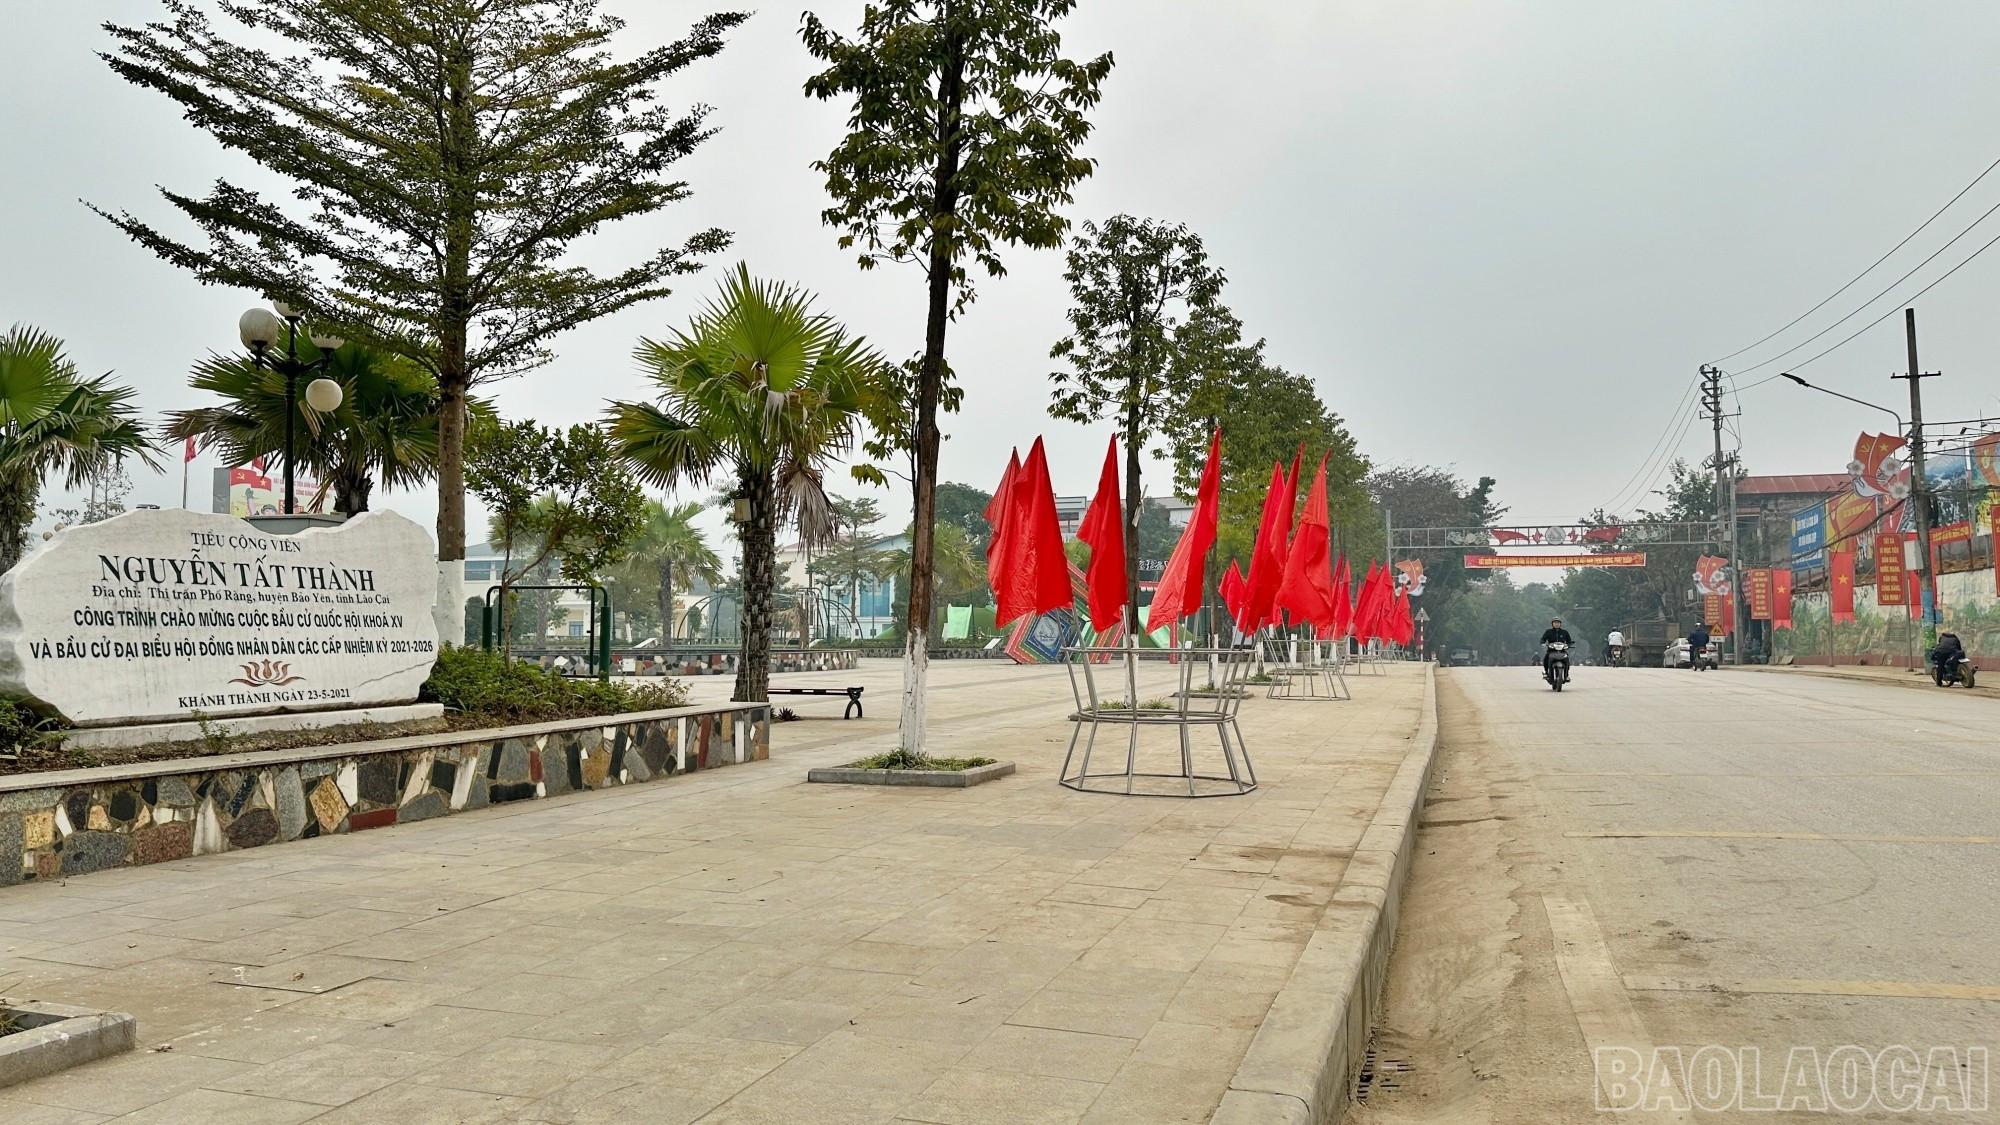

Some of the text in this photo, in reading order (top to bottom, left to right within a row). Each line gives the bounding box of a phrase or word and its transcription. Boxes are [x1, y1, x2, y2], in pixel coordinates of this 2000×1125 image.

[228, 534, 267, 550] CÔNG
[270, 538, 301, 552] VIÊN
[98, 548, 376, 591] NGUYỄN TẤT THÀNH
[172, 588, 197, 600] trấn
[200, 588, 222, 601] Phố
[224, 588, 256, 604] Ràng,
[258, 591, 289, 605] huyện
[356, 593, 373, 604] Lào
[74, 606, 403, 632] CÔNG TRÌNH CHÀO MỪNG CUỘC BẦU CỬ QUỐC HỘI KHOÁ XV
[30, 633, 433, 662] VÀ BẦU CỬ ĐẠI BIỂU HỘI ĐỒNG NHÂN DÂN CÁC CẤP NHIỆM KỲ 2021-2026
[178, 688, 350, 708] KHÁNH THÀNH NGÀY 23-5-2021
